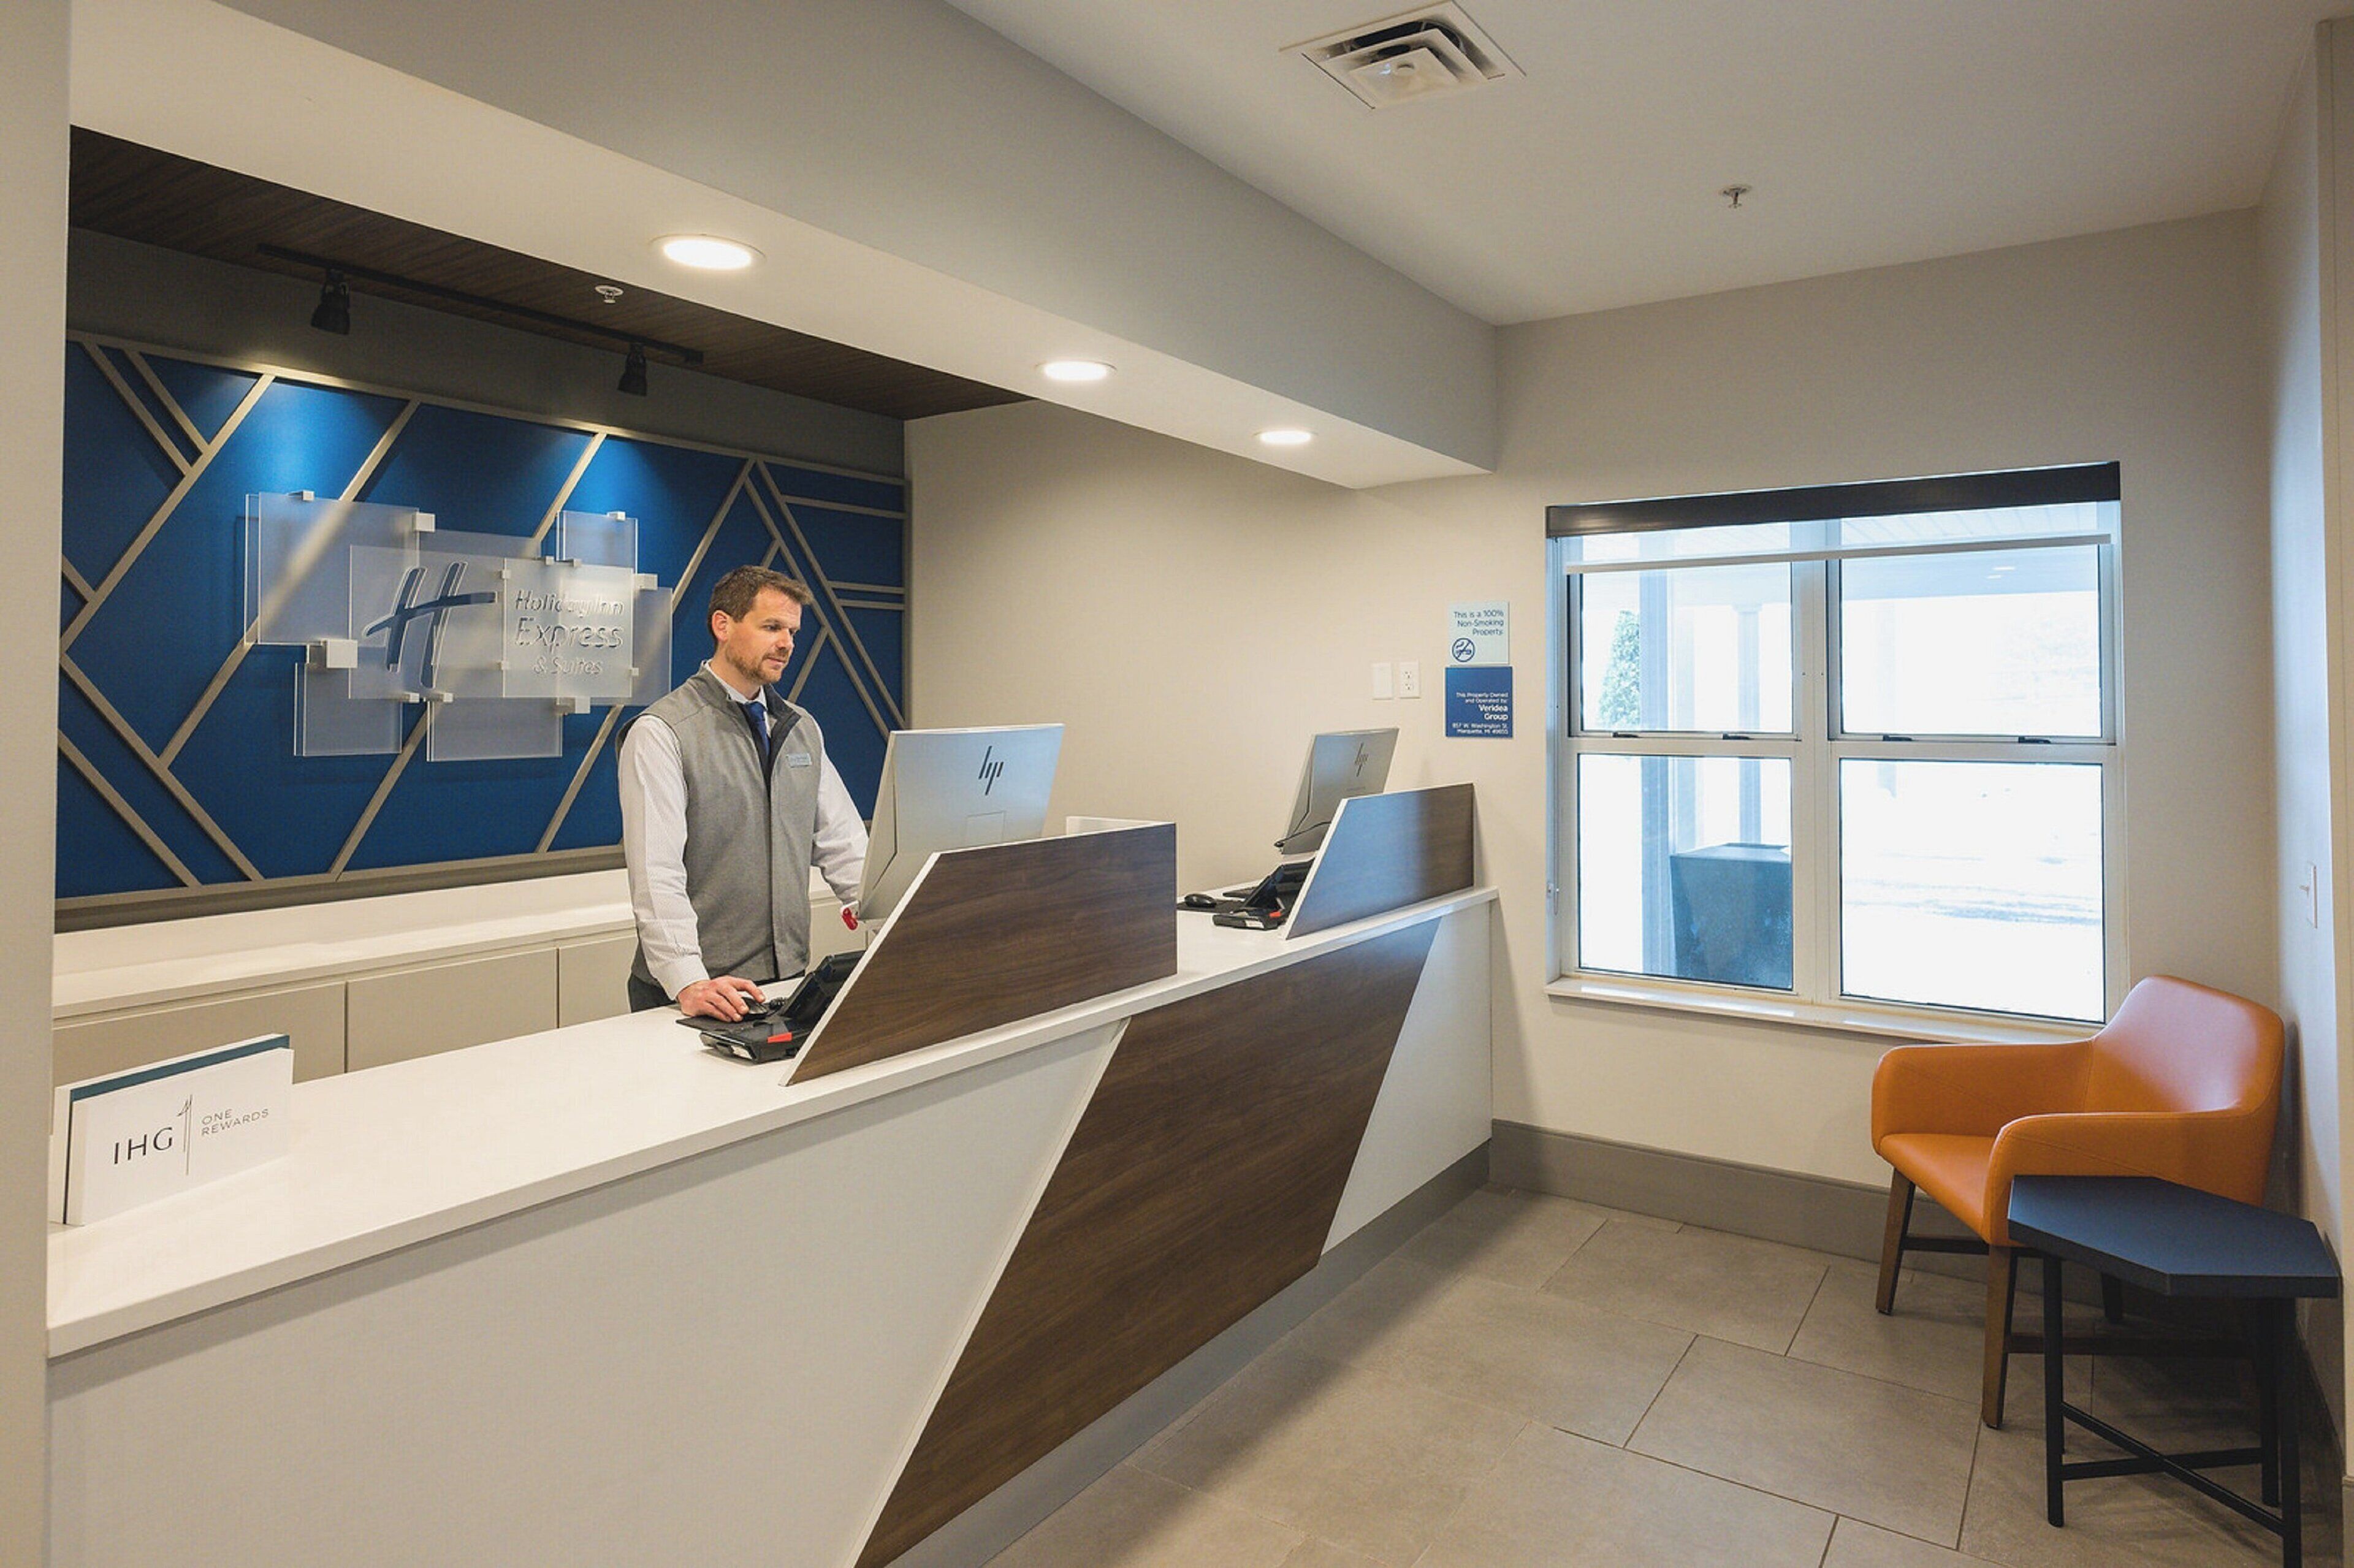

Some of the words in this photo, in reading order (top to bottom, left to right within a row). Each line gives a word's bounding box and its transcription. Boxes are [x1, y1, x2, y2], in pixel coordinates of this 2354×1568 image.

[516, 615, 623, 654] Express
[533, 655, 547, 674] &
[551, 656, 603, 675] Suites
[978, 745, 1004, 796] hp
[201, 1109, 269, 1136] REWARDS
[202, 1109, 232, 1126] ONE
[114, 1127, 173, 1164] IHG
